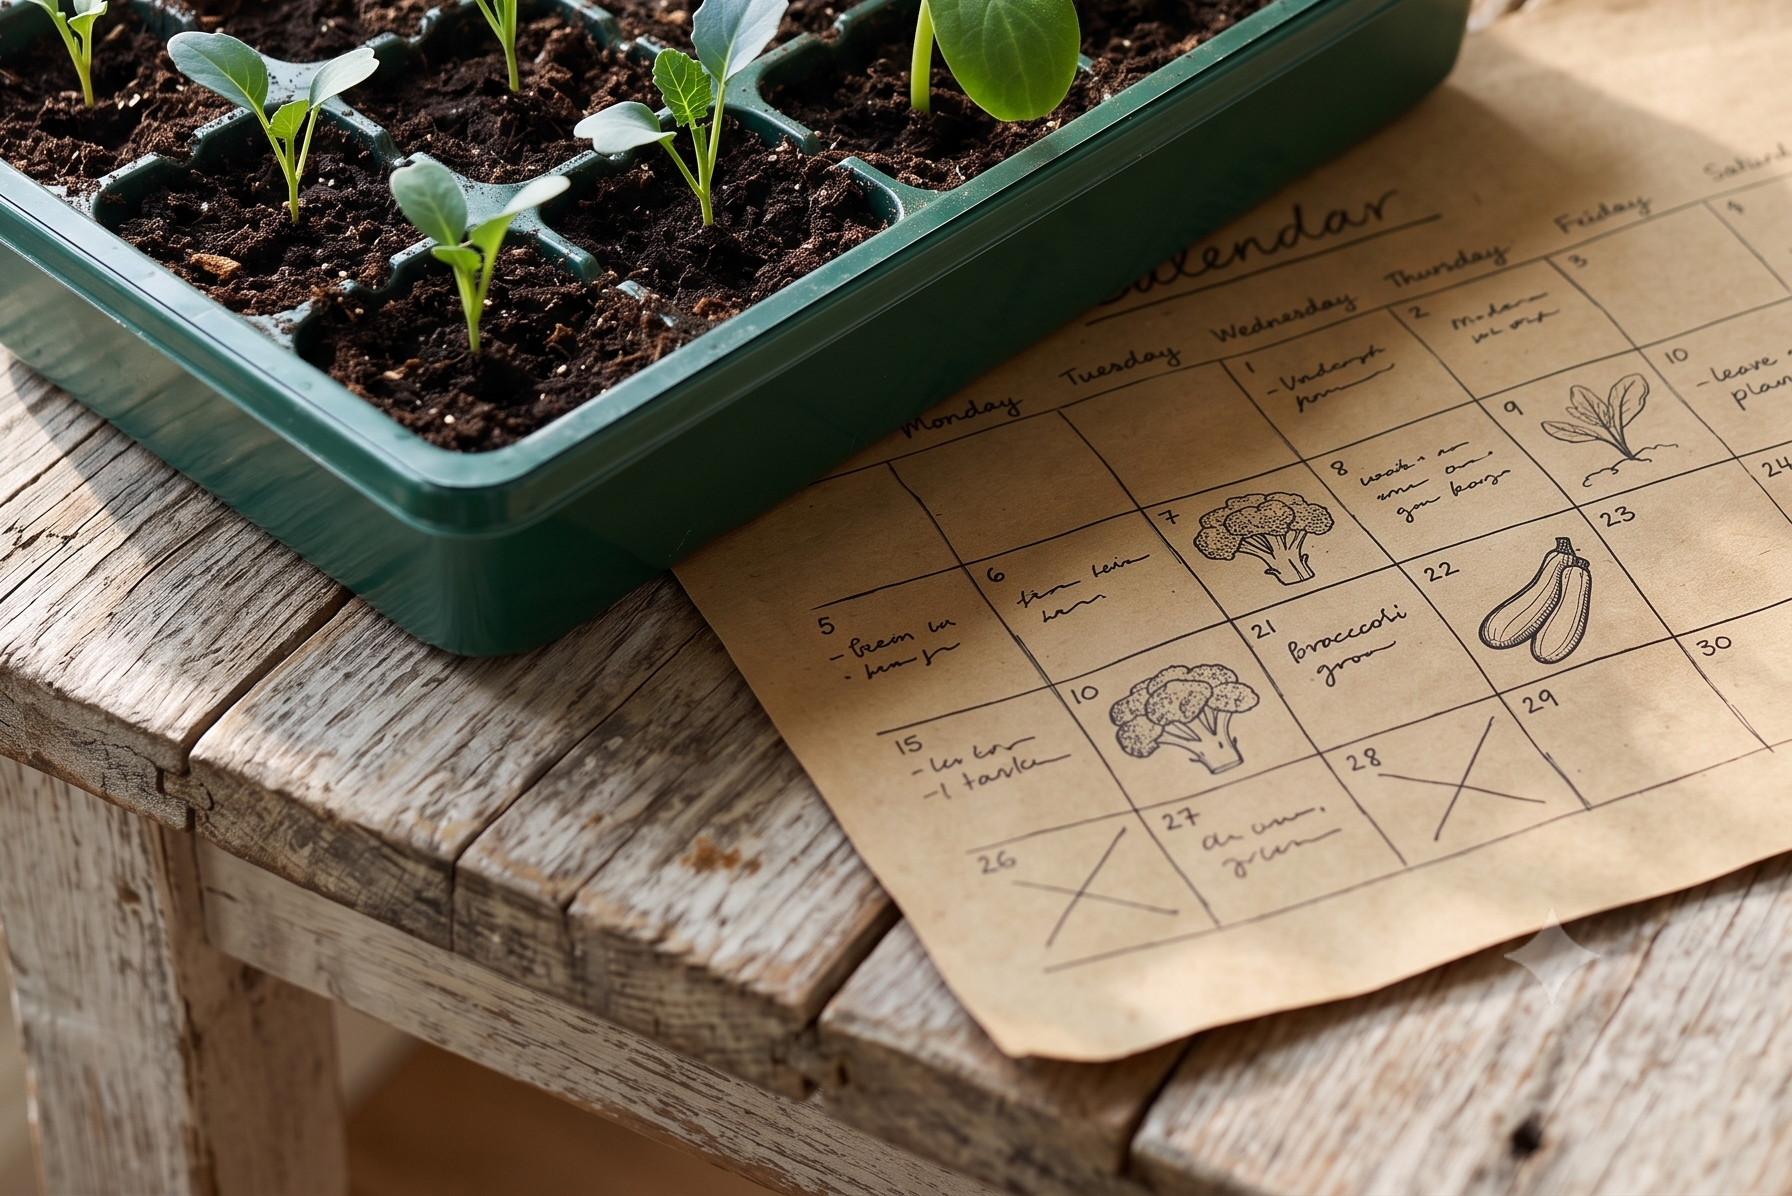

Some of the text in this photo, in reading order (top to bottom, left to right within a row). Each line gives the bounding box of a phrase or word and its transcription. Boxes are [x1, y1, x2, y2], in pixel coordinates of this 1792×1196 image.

[1568, 254, 1588, 268] 3
[898, 394, 1024, 440] Monday
[1056, 344, 1184, 387] Tuesday
[1210, 293, 1358, 344] Wednesday
[1382, 244, 1513, 288] Thursday
[1553, 195, 1656, 235] Friday
[1408, 305, 1430, 320] 2
[1664, 348, 1689, 365] 10
[1244, 361, 1256, 374] 1
[1503, 400, 1524, 416] 9
[1330, 460, 1349, 477] 8
[1761, 456, 1792, 478] 24
[1157, 509, 1180, 525] 7
[1599, 505, 1636, 528] 23
[986, 566, 1006, 583] 6
[1423, 561, 1461, 583] 22
[817, 616, 836, 636] 5
[1250, 619, 1277, 640] 21
[1695, 636, 1732, 657] 30
[1070, 685, 1099, 705] 10
[1522, 688, 1559, 714] 29
[894, 734, 923, 756] 15
[1345, 747, 1383, 773] 28
[1162, 807, 1200, 831] 27
[977, 850, 1017, 875] 26
